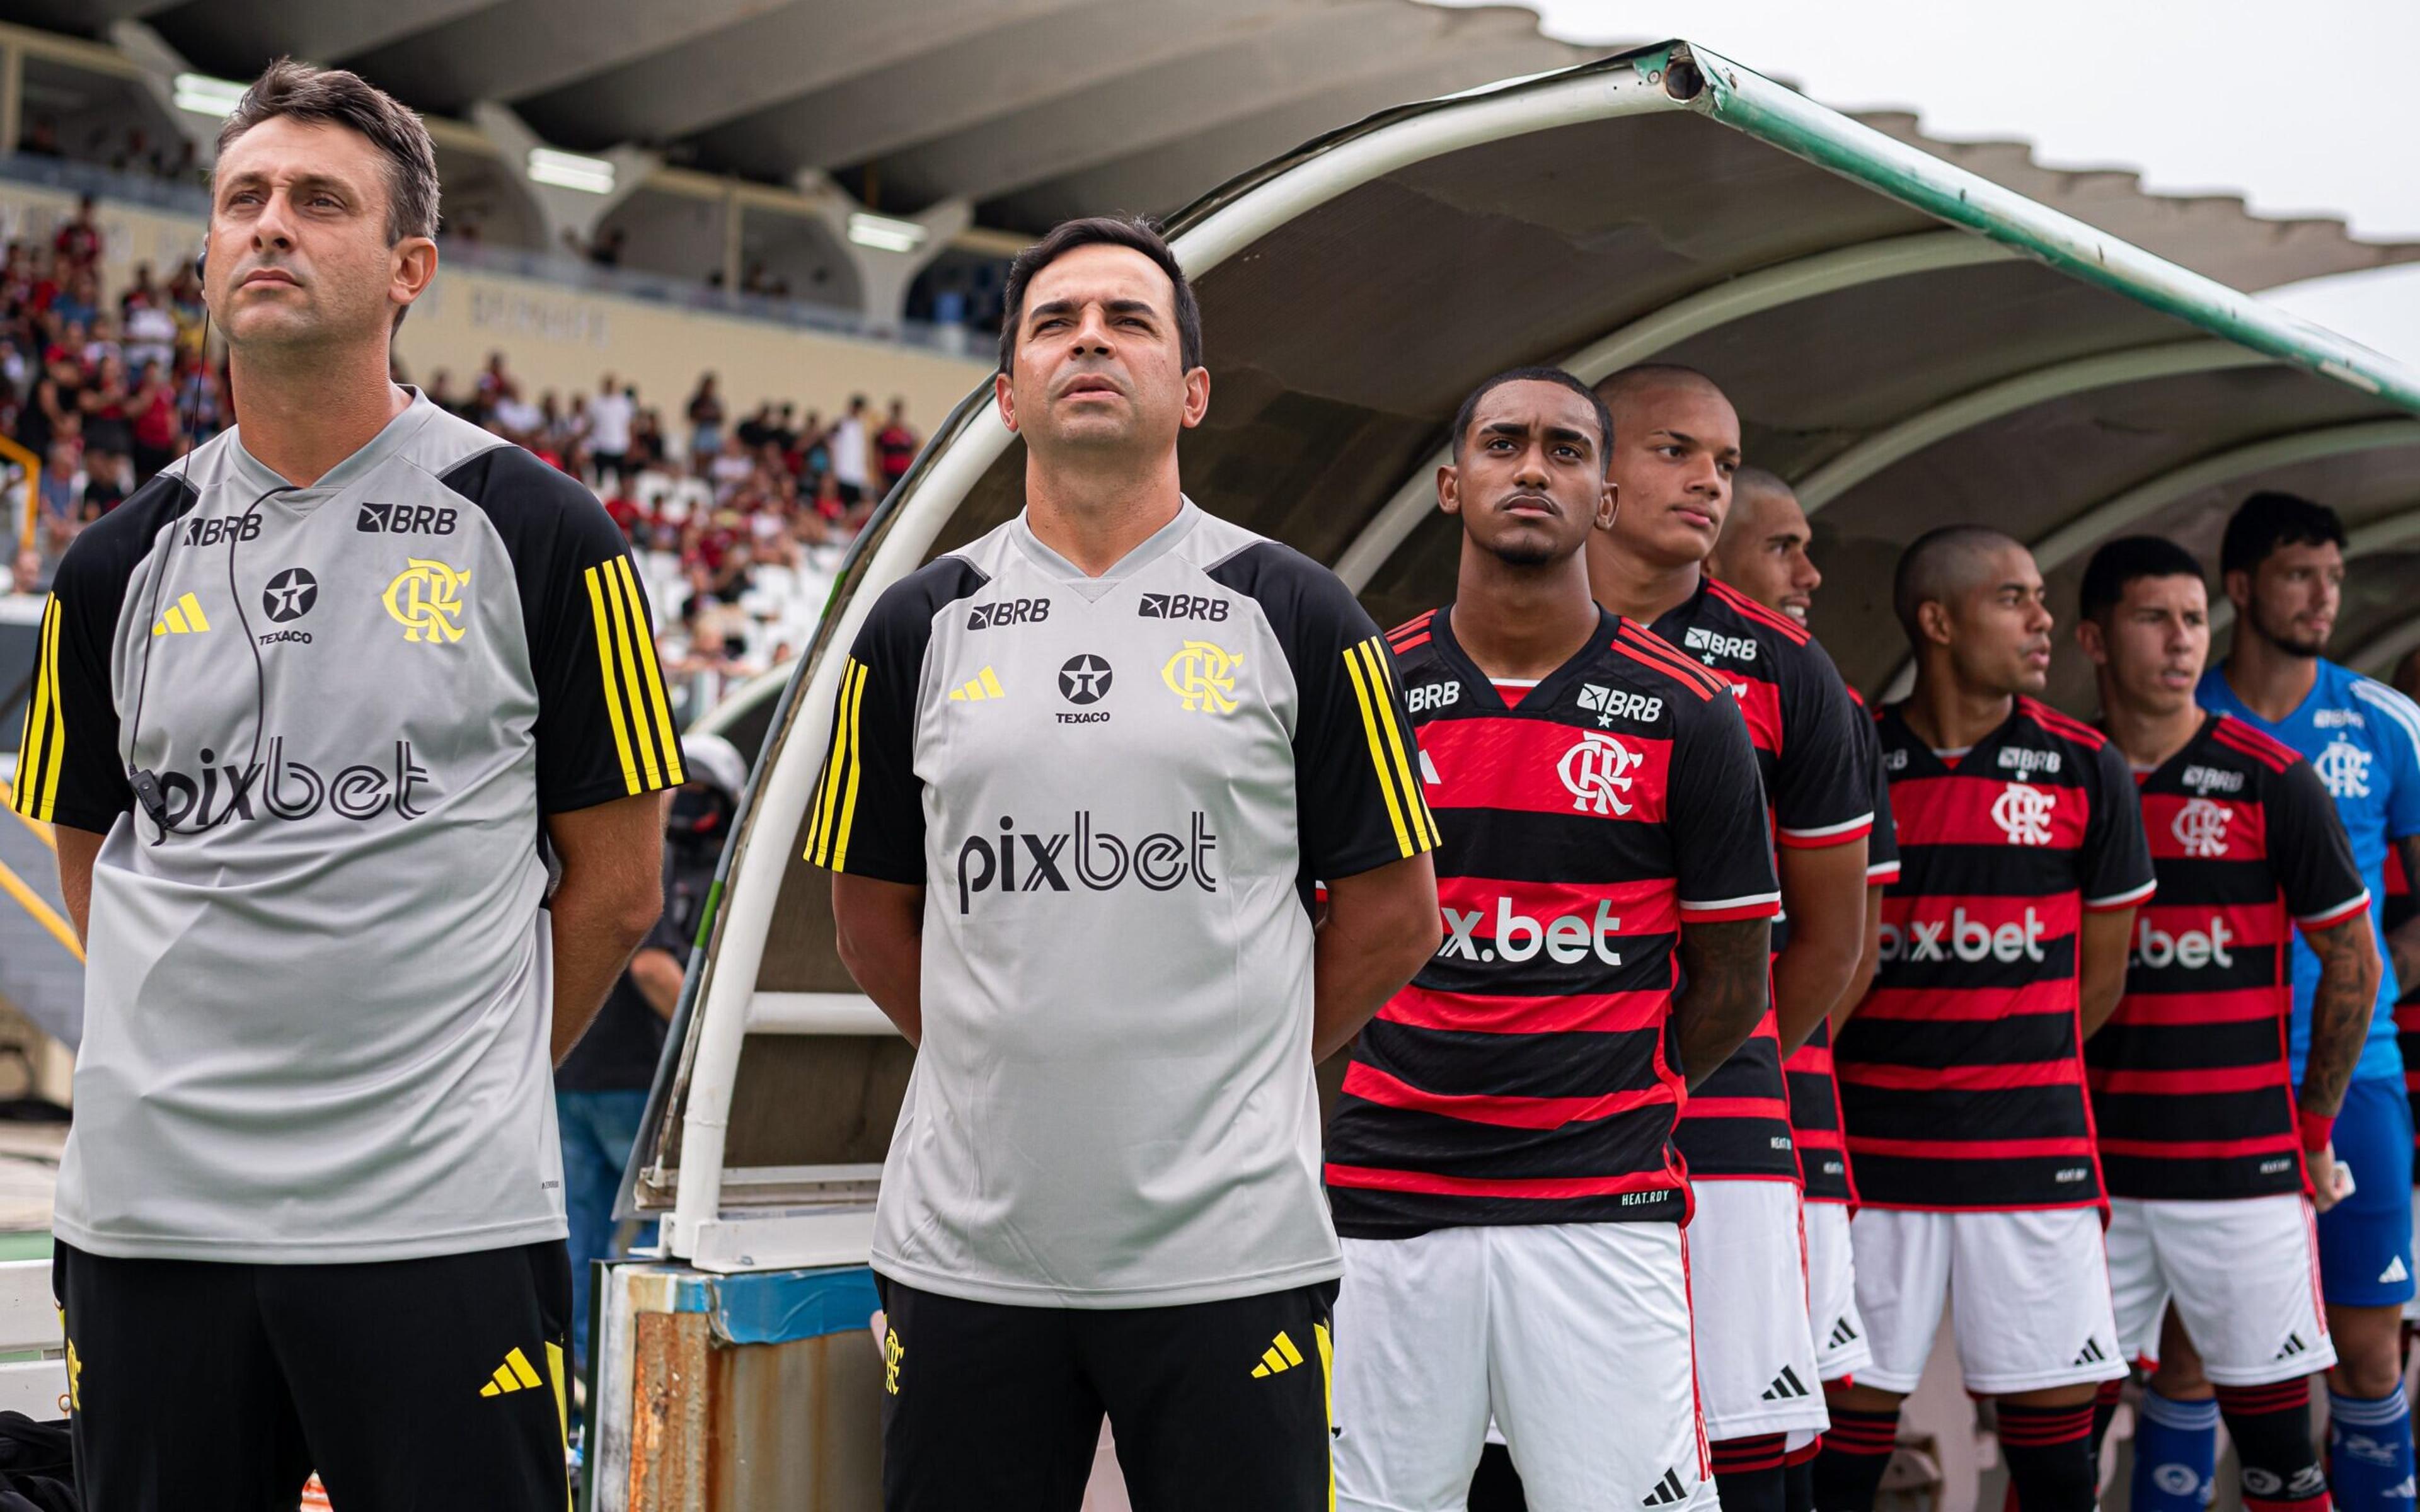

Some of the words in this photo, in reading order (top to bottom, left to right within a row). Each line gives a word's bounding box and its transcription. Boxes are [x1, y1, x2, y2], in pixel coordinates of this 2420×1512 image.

[201, 513, 262, 546] BRB
[391, 505, 458, 535] BRB
[993, 598, 1051, 627] BRB
[1169, 593, 1230, 622] BRB
[259, 631, 313, 646] TEXACO
[1709, 633, 1757, 660] BRB
[1409, 680, 1460, 713] BRB
[1608, 689, 1663, 723] BRB
[1055, 711, 1111, 724] TEXACO
[151, 736, 429, 847] pixbet
[957, 810, 1217, 915] pixbet
[1622, 1189, 1669, 1206] HEAT.RDY
